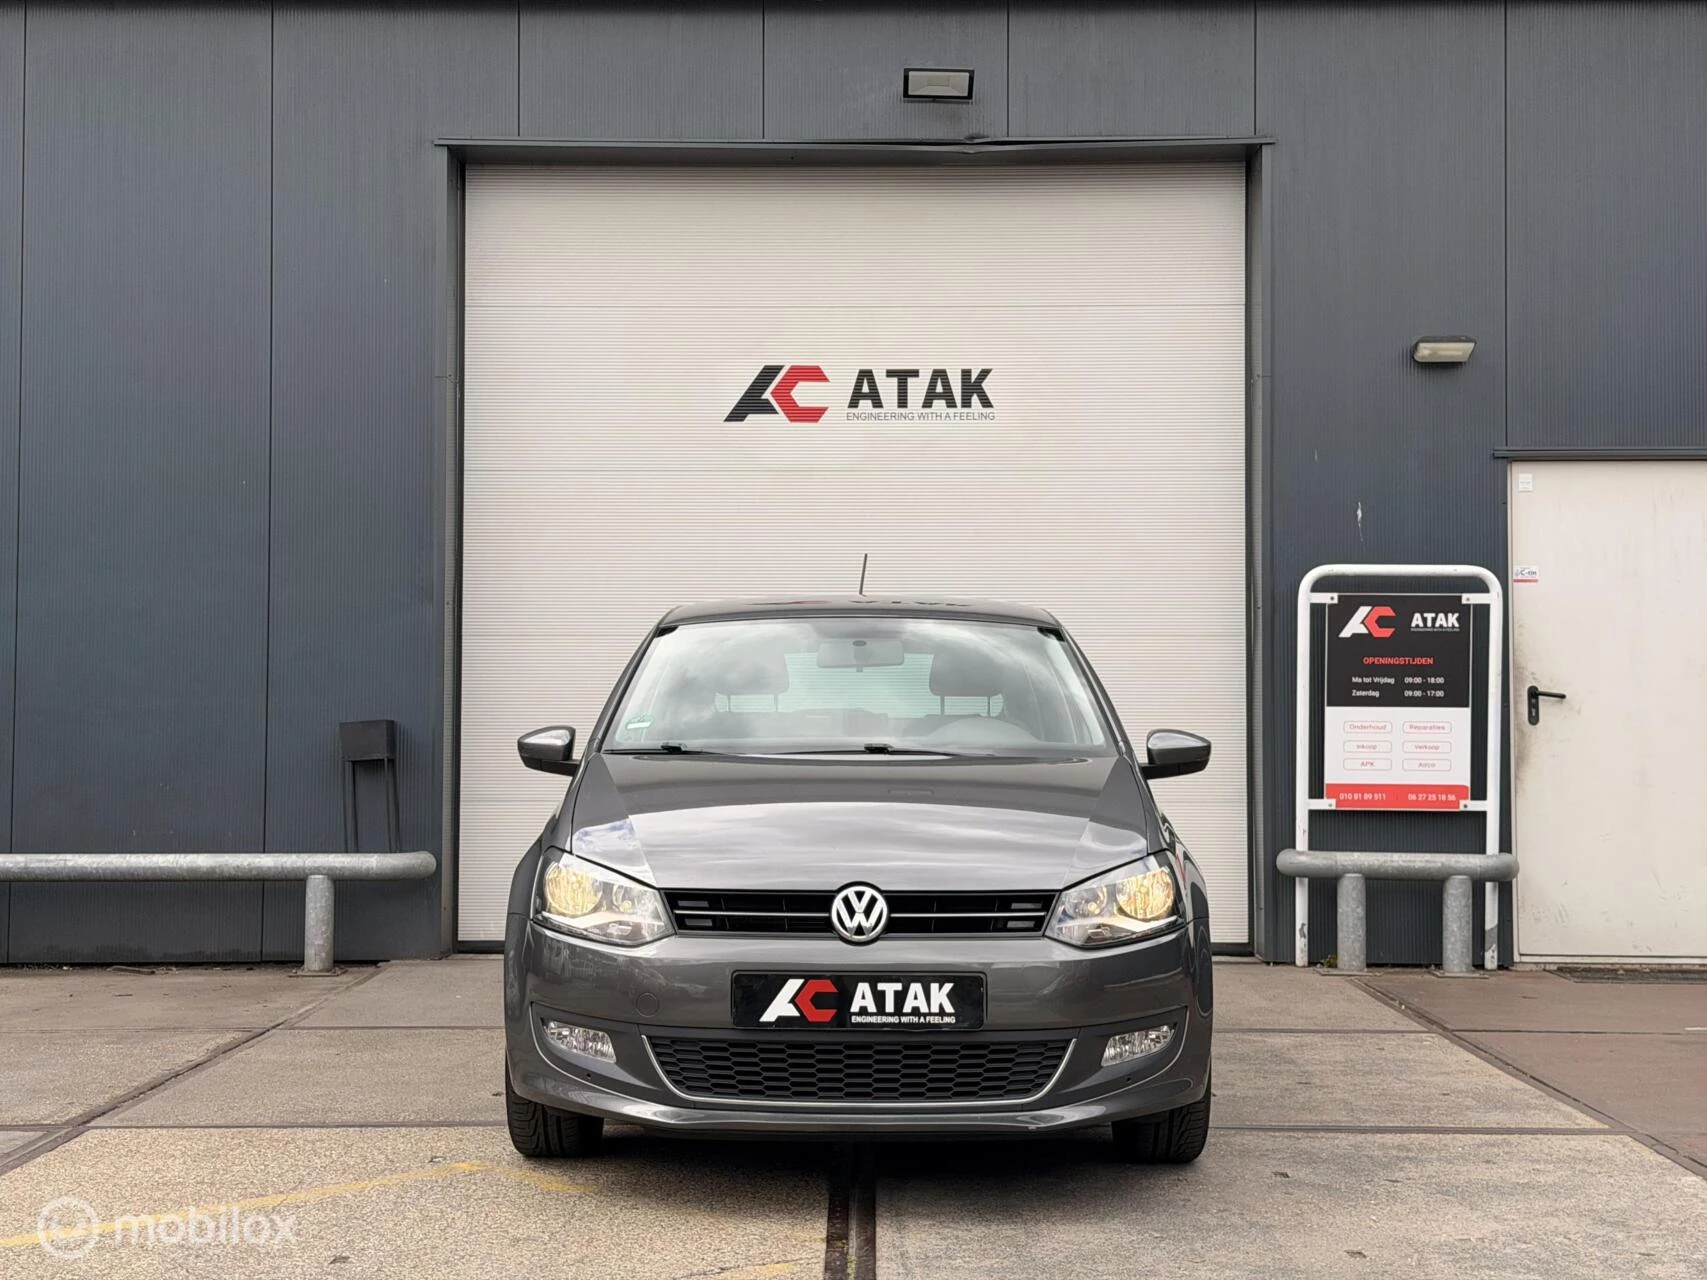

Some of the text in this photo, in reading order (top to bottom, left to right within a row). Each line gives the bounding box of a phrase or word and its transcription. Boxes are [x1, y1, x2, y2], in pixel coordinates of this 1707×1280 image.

[847, 369, 993, 408] ATAK
[846, 412, 995, 421] ENGINEERING WITH A FEELING
[1411, 612, 1460, 628] ATAK
[1363, 657, 1434, 665] OPENINGSTIJDEN
[1373, 676, 1395, 685] Vrijdag
[1352, 689, 1380, 697] Zaterdag
[1356, 743, 1377, 751] Inkoop
[1408, 793, 1417, 801] 06
[850, 982, 955, 1013] ATAK
[851, 1016, 956, 1024] ENGINEERING WITH A FEELING
